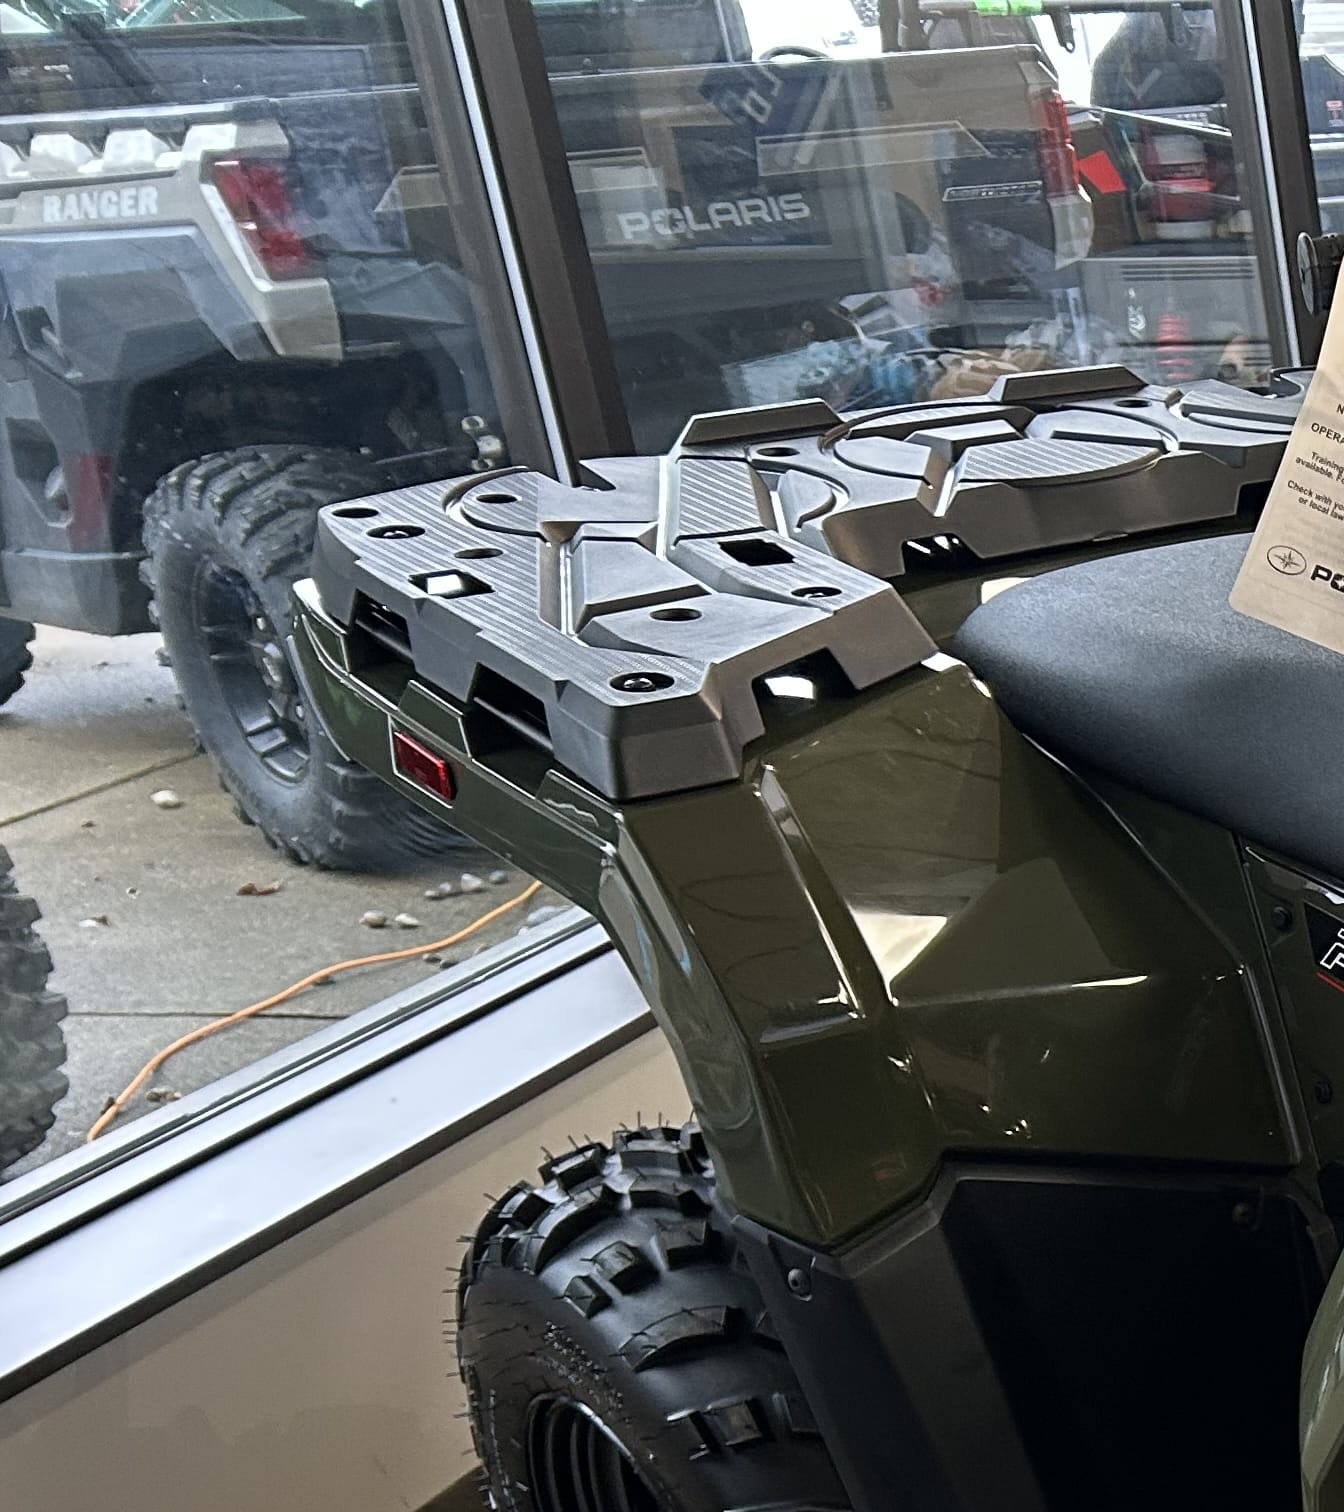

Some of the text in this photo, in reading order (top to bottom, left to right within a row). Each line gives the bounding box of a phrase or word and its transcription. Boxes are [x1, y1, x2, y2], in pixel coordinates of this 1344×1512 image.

[43, 185, 158, 223] RANGER
[616, 192, 811, 240] POLARIS
[1311, 451, 1344, 475] Training
[1287, 479, 1313, 498] Check
